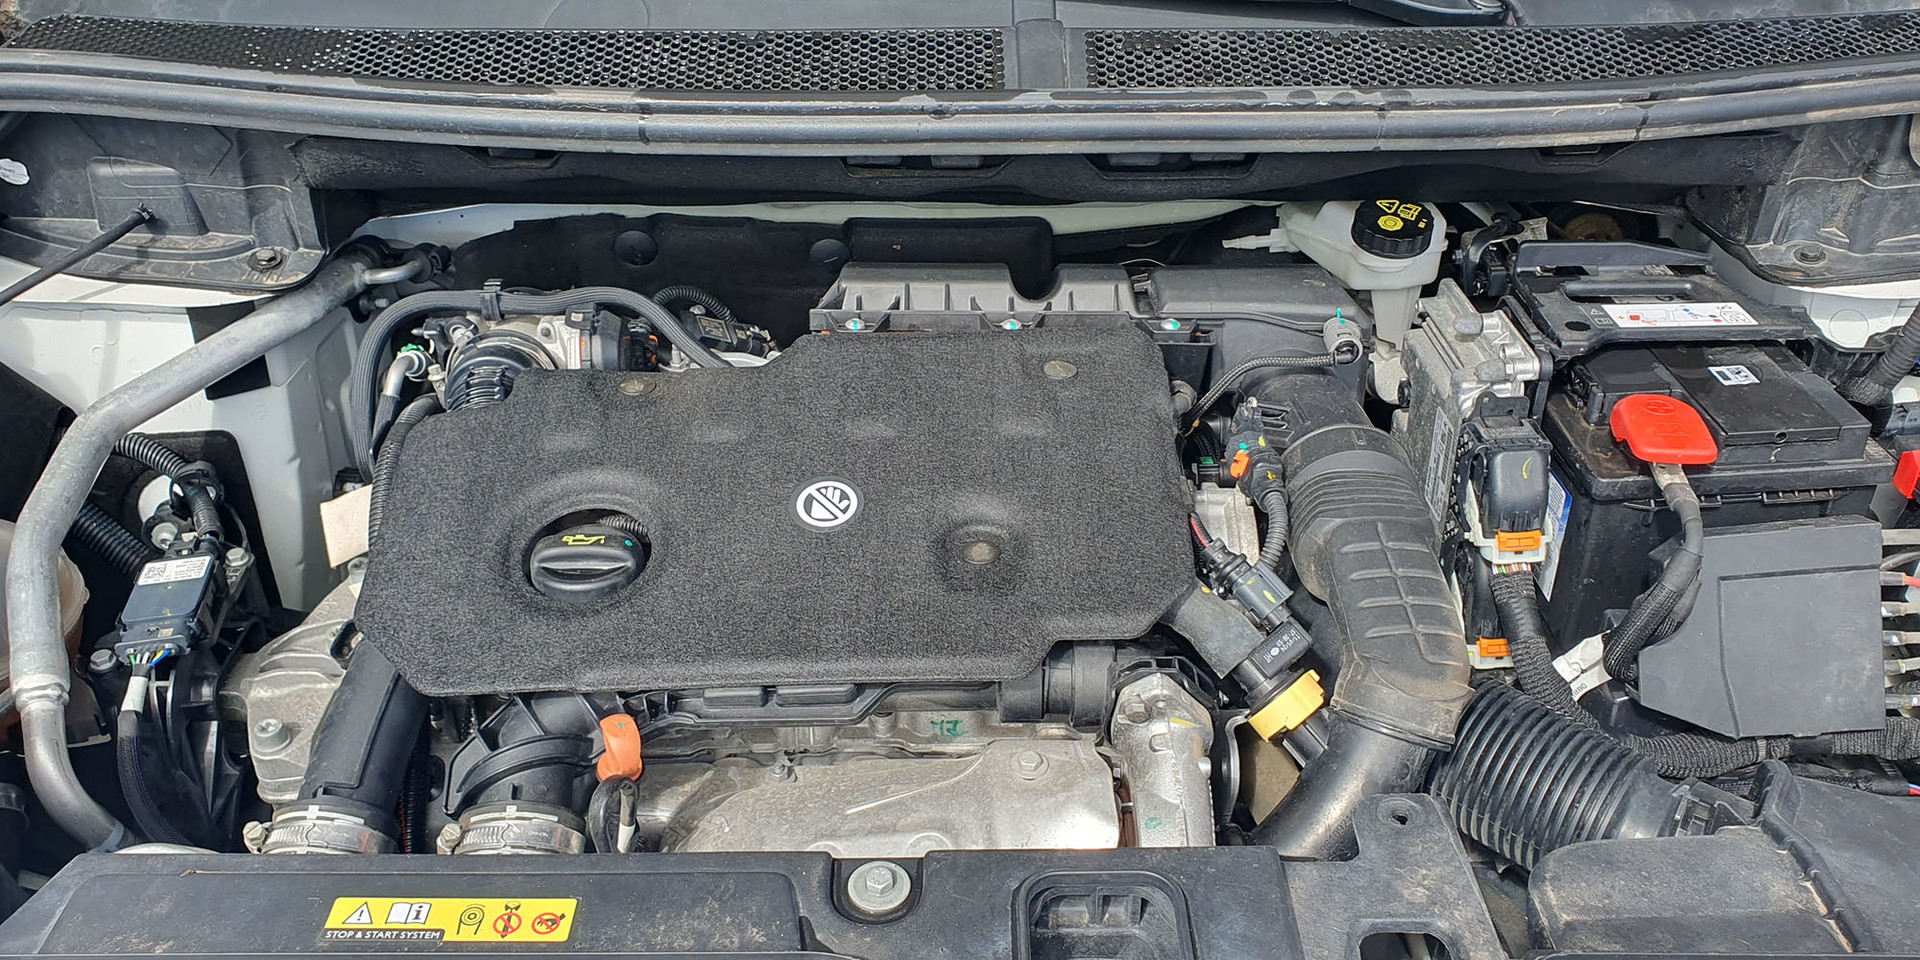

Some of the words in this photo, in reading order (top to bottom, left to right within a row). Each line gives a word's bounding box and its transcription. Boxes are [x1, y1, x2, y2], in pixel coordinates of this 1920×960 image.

[325, 930, 354, 939] STOP
[355, 930, 363, 939] &
[364, 930, 397, 939] START
[399, 930, 441, 939] SYSTEM
